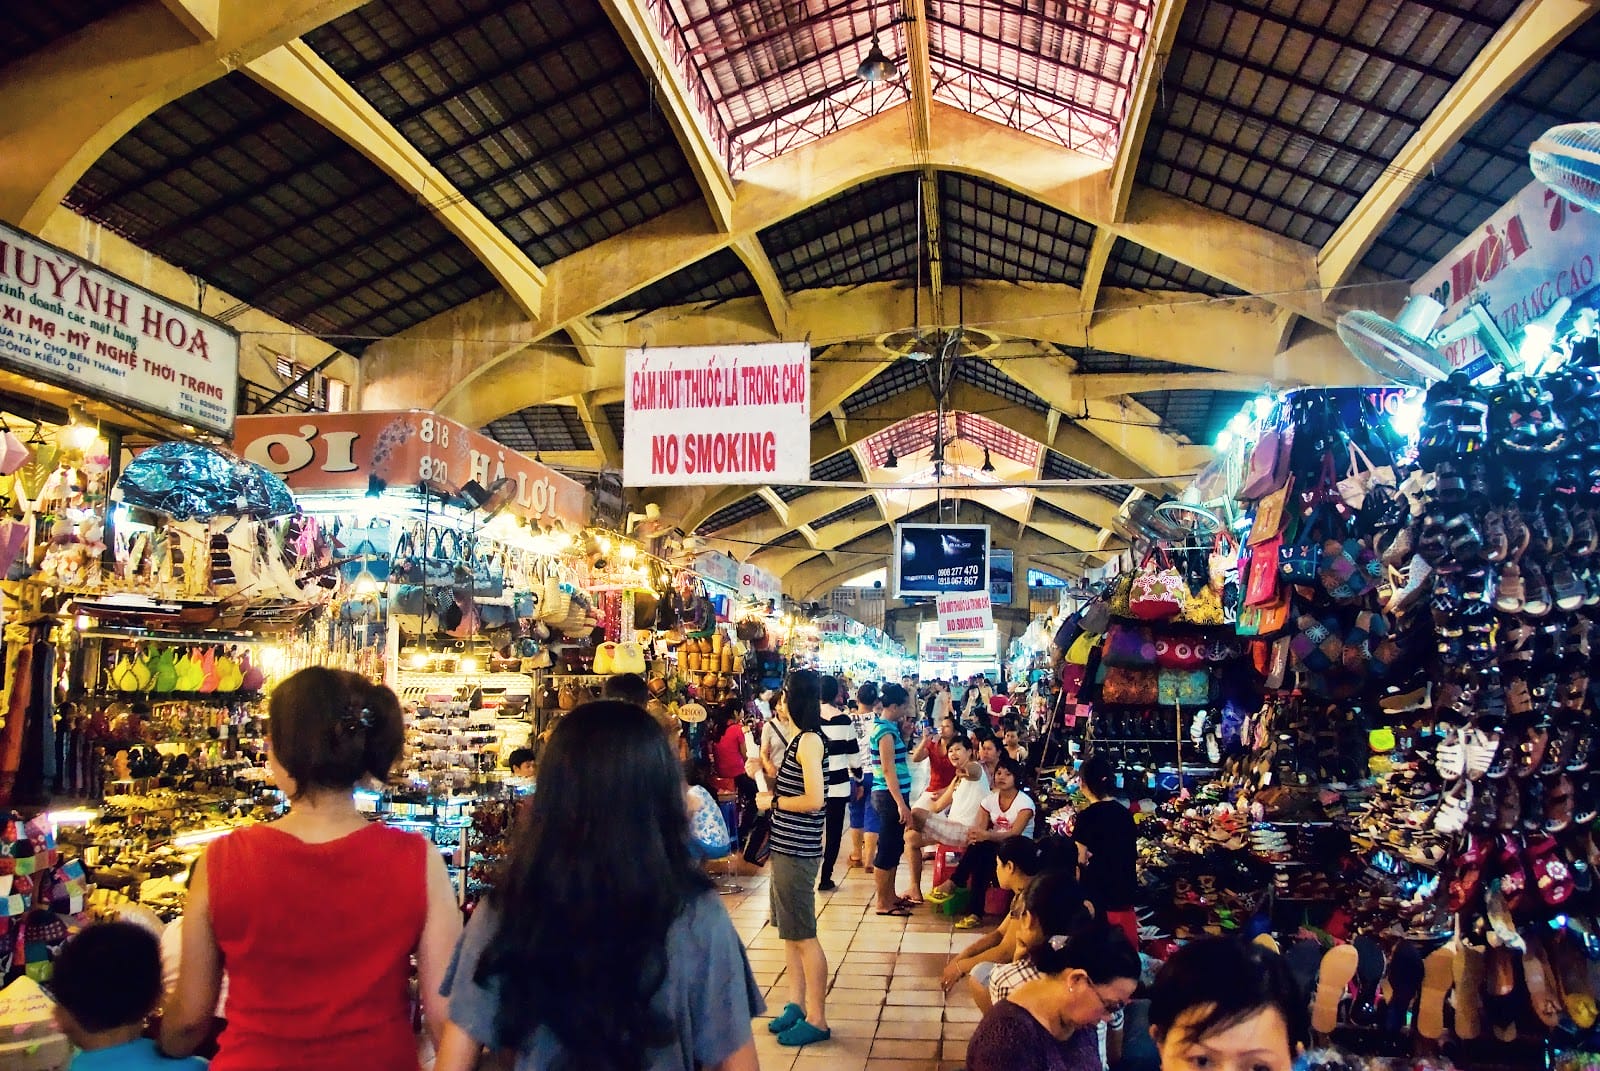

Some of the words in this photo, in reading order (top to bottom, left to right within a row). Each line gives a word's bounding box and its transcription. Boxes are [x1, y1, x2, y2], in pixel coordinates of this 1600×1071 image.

[1556, 255, 1594, 298] CAO
[29, 292, 65, 316] doanh
[142, 304, 212, 363] HOA
[29, 314, 56, 339] MẠ
[179, 372, 225, 401] TRANG
[632, 357, 656, 411] CẤM
[659, 361, 682, 410] HÚT
[684, 355, 722, 409] THUỐC
[724, 357, 739, 407] LÁ
[741, 364, 779, 406] TRONG
[782, 355, 806, 414] CHỢ
[420, 417, 449, 449] 818
[419, 455, 448, 485] 820
[651, 433, 679, 475] NO
[684, 431, 776, 475] SMOKING
[517, 471, 557, 520] LỢI
[963, 564, 979, 575] 470
[963, 575, 979, 586] 867
[947, 619, 956, 631] NO
[957, 616, 984, 630] SMOKING
